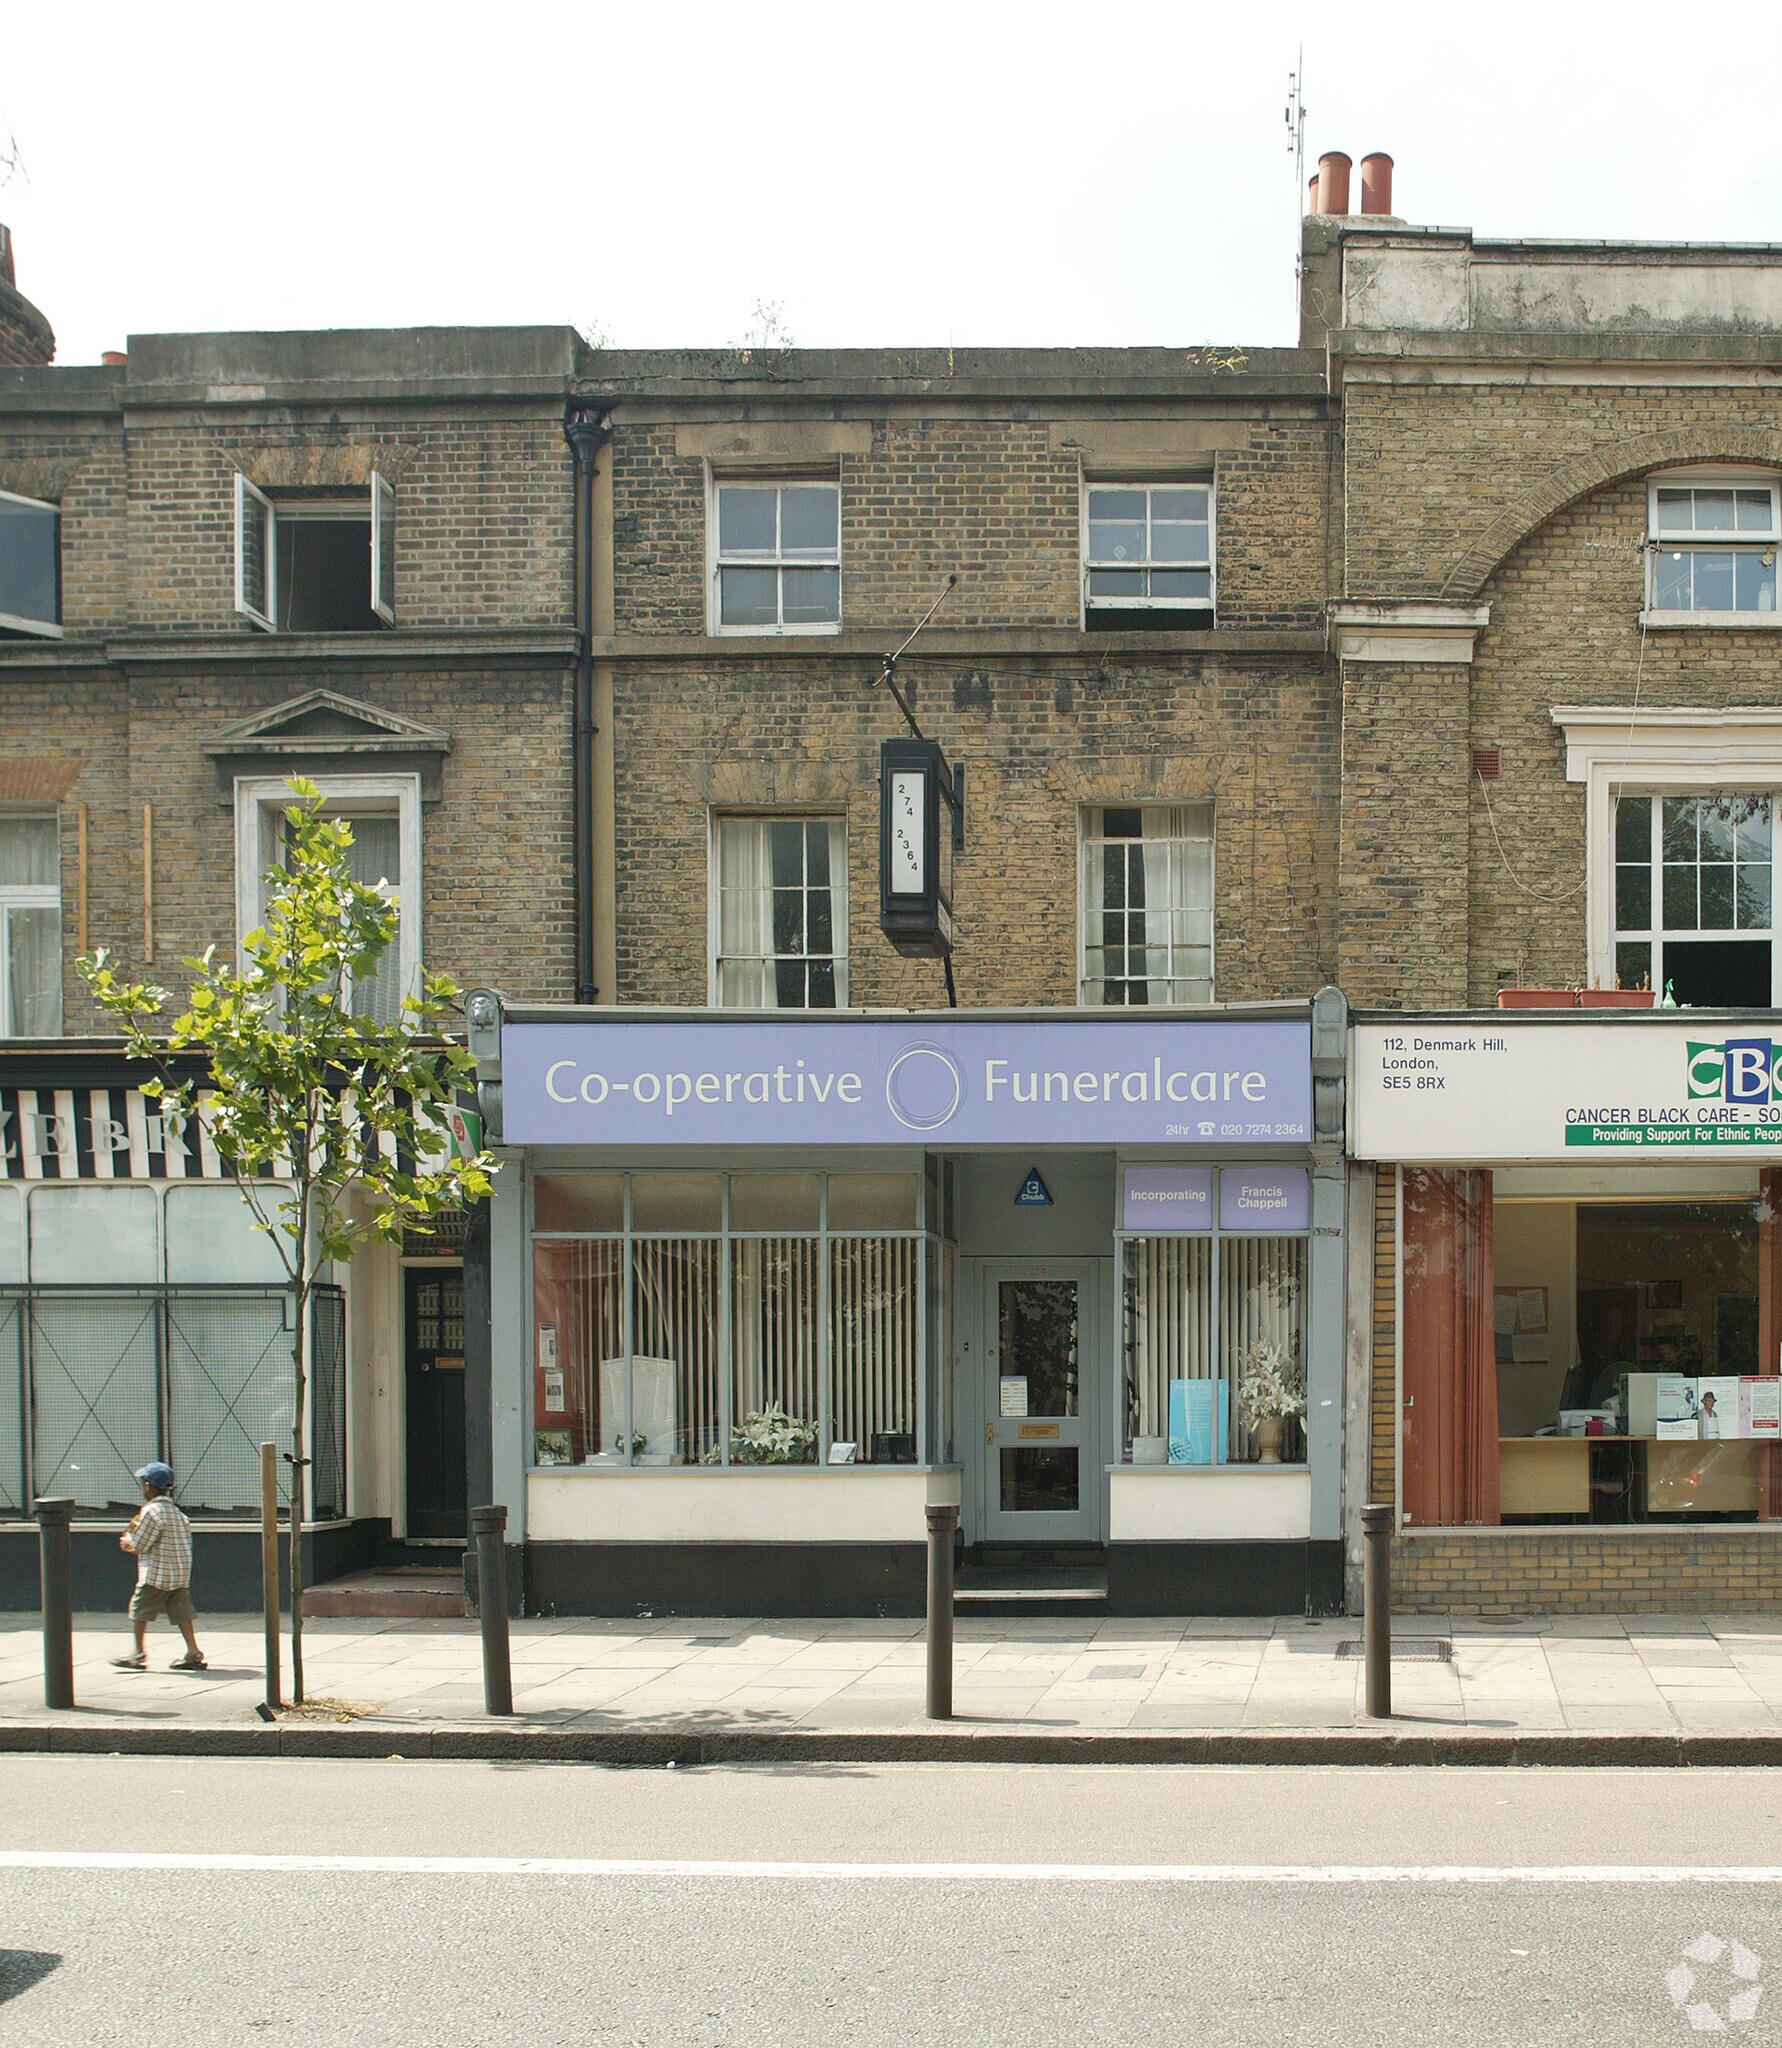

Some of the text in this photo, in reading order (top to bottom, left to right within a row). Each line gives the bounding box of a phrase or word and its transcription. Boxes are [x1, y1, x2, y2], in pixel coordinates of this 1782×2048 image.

[1383, 1038, 1508, 1052] 112, Denmark Hill,
[1382, 1057, 1439, 1070] London,
[1688, 1048, 1782, 1097] CB
[545, 1057, 1267, 1115] Co-operative Funeralcare
[1382, 1076, 1446, 1090] SE5 8RX
[1565, 1108, 1631, 1123] CANCER
[1638, 1108, 1690, 1123] BLACK
[1697, 1108, 1739, 1123] CARE
[1758, 1107, 1782, 1123] SO
[1166, 1124, 1303, 1136] 24hr 020 7274 2364
[1592, 1127, 1782, 1144] Providing Support For Ethnic Peop
[1021, 1193, 1045, 1201] Chubb
[1130, 1189, 1206, 1203] Incorporating
[1241, 1185, 1283, 1197] Francis
[1237, 1197, 1288, 1210] Chappell
